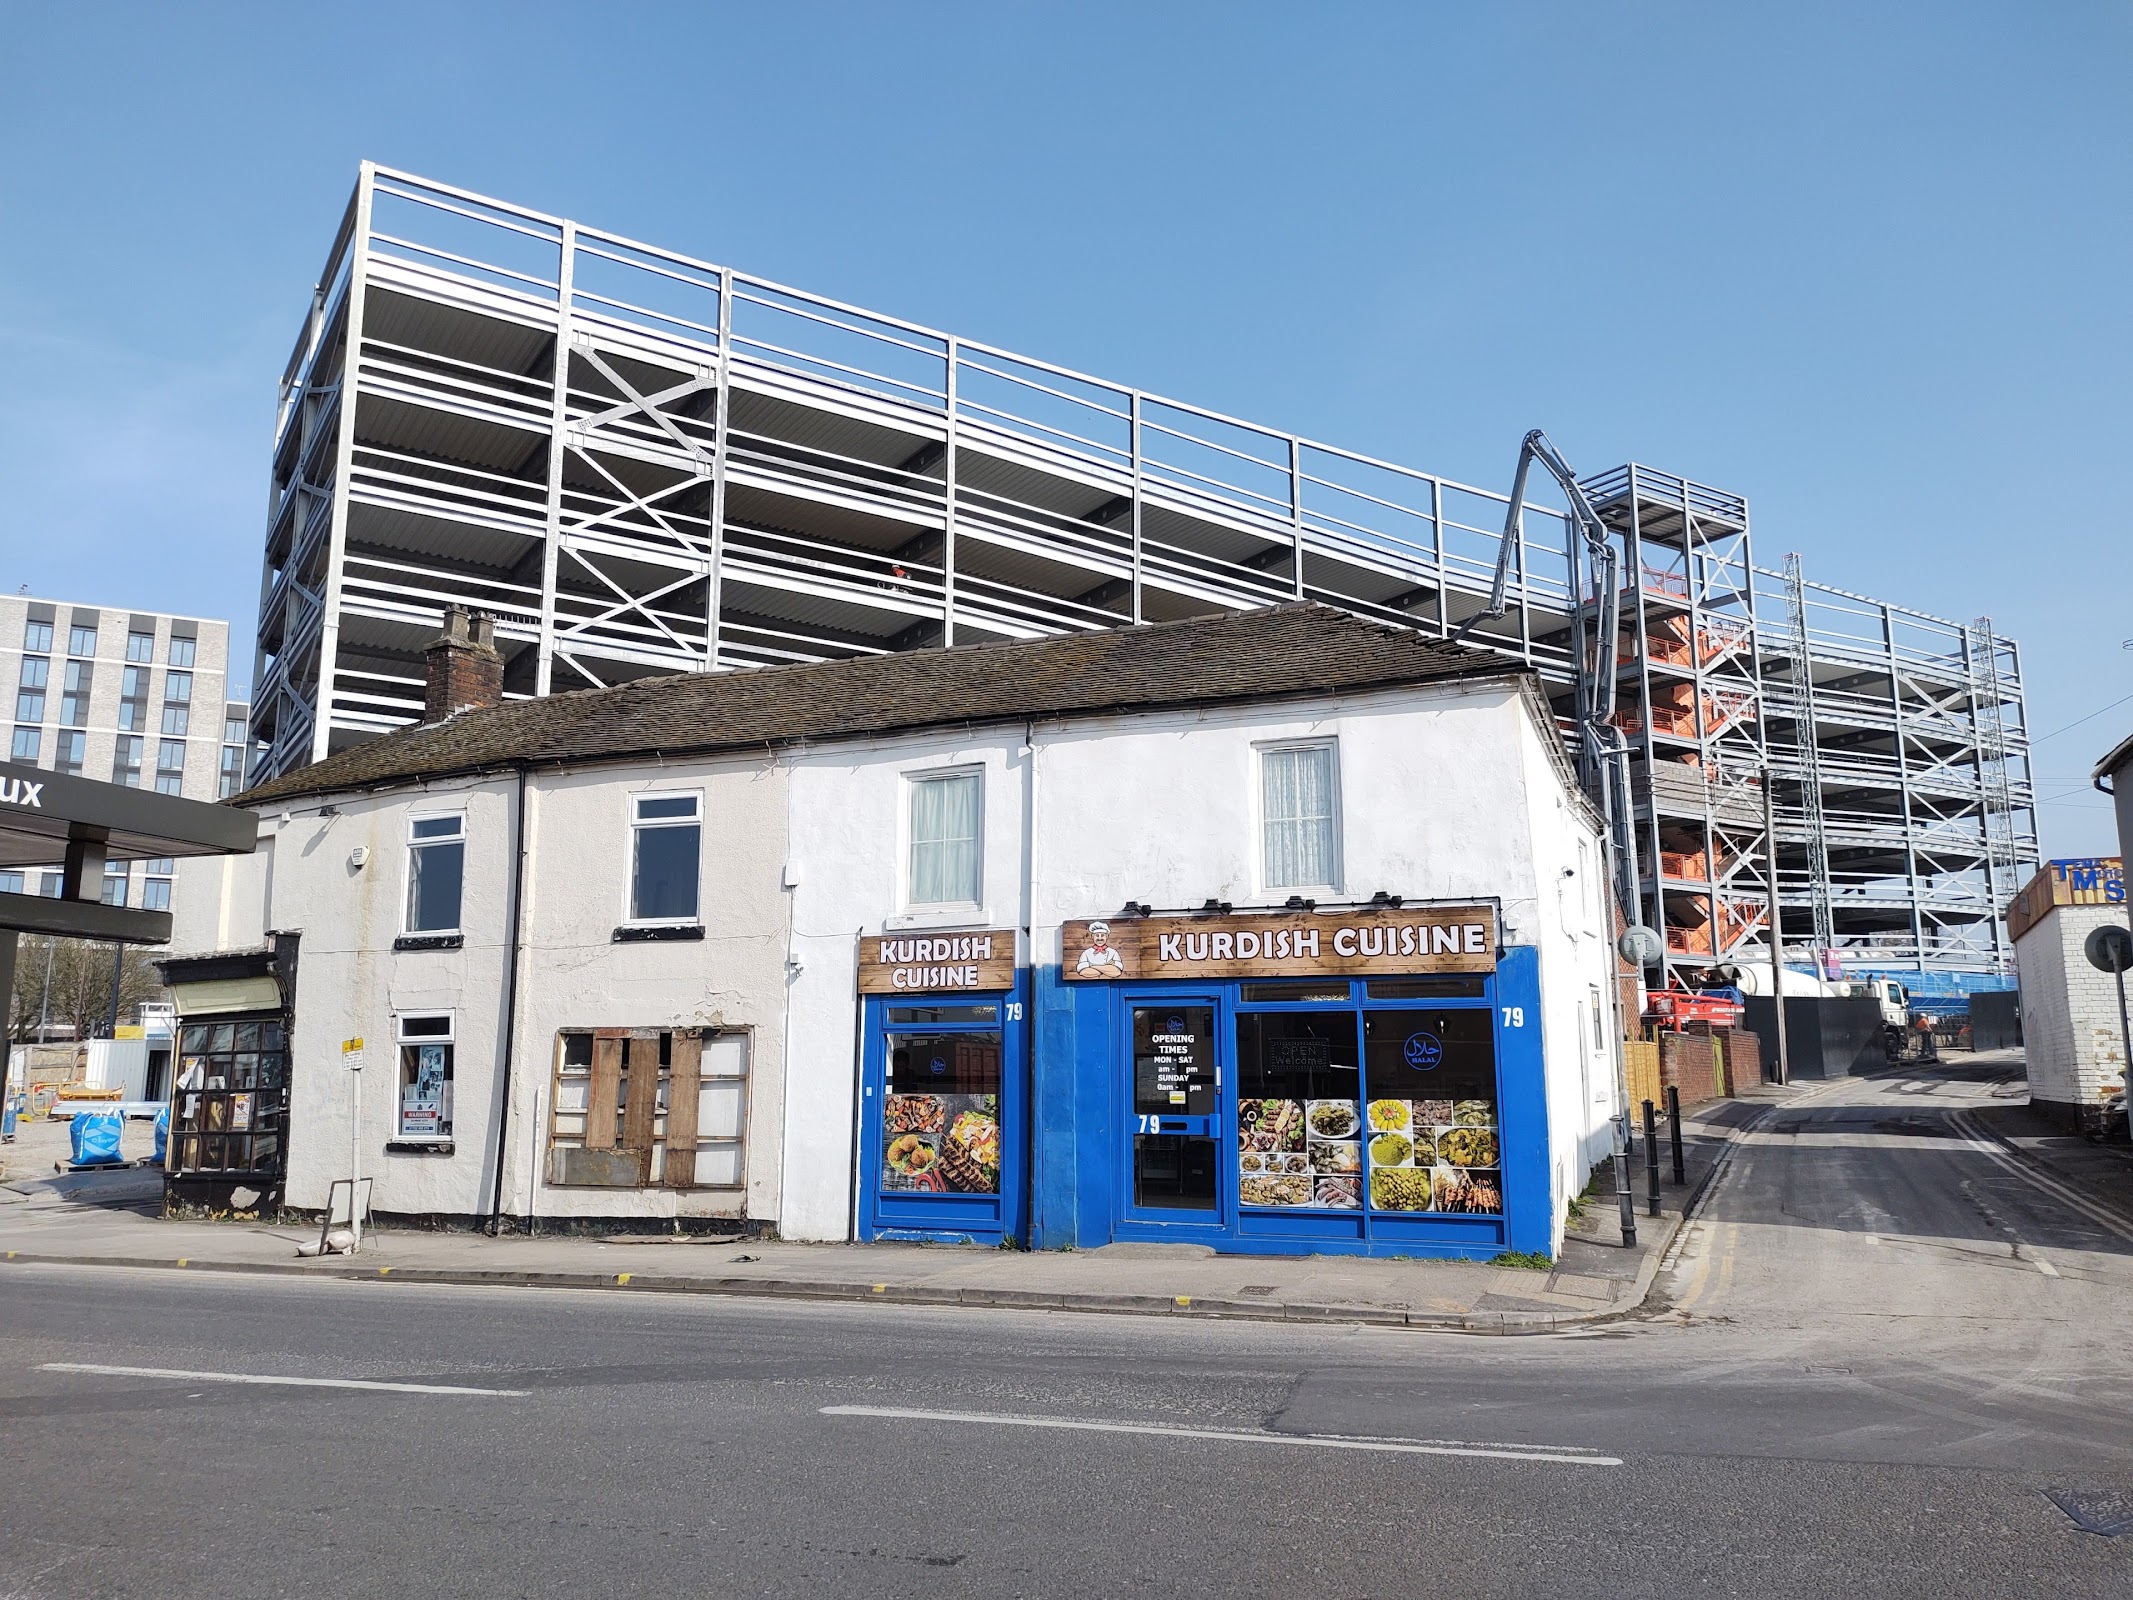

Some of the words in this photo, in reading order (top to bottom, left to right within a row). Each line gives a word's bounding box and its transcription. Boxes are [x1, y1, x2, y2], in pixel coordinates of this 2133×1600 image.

[1159, 929, 1320, 961] KURDISH
[1333, 924, 1486, 957] CUISINE
[880, 936, 991, 963] KURDISH
[892, 965, 978, 988] CUISINE
[1006, 1002, 1023, 1021] 79
[1501, 1007, 1524, 1028] 79
[1151, 1034, 1195, 1043] OPENING
[1158, 1045, 1188, 1054] TIMES
[1281, 1046, 1317, 1056] OPEN
[1406, 1038, 1440, 1057] حلال
[1153, 1056, 1172, 1064] MON
[1178, 1056, 1194, 1064] SAT
[1275, 1056, 1323, 1066] Welcome
[1185, 1066, 1198, 1075] pm
[1157, 1074, 1189, 1082] SUNDAY
[1189, 1084, 1202, 1093] pm
[1139, 1114, 1160, 1134] 79
